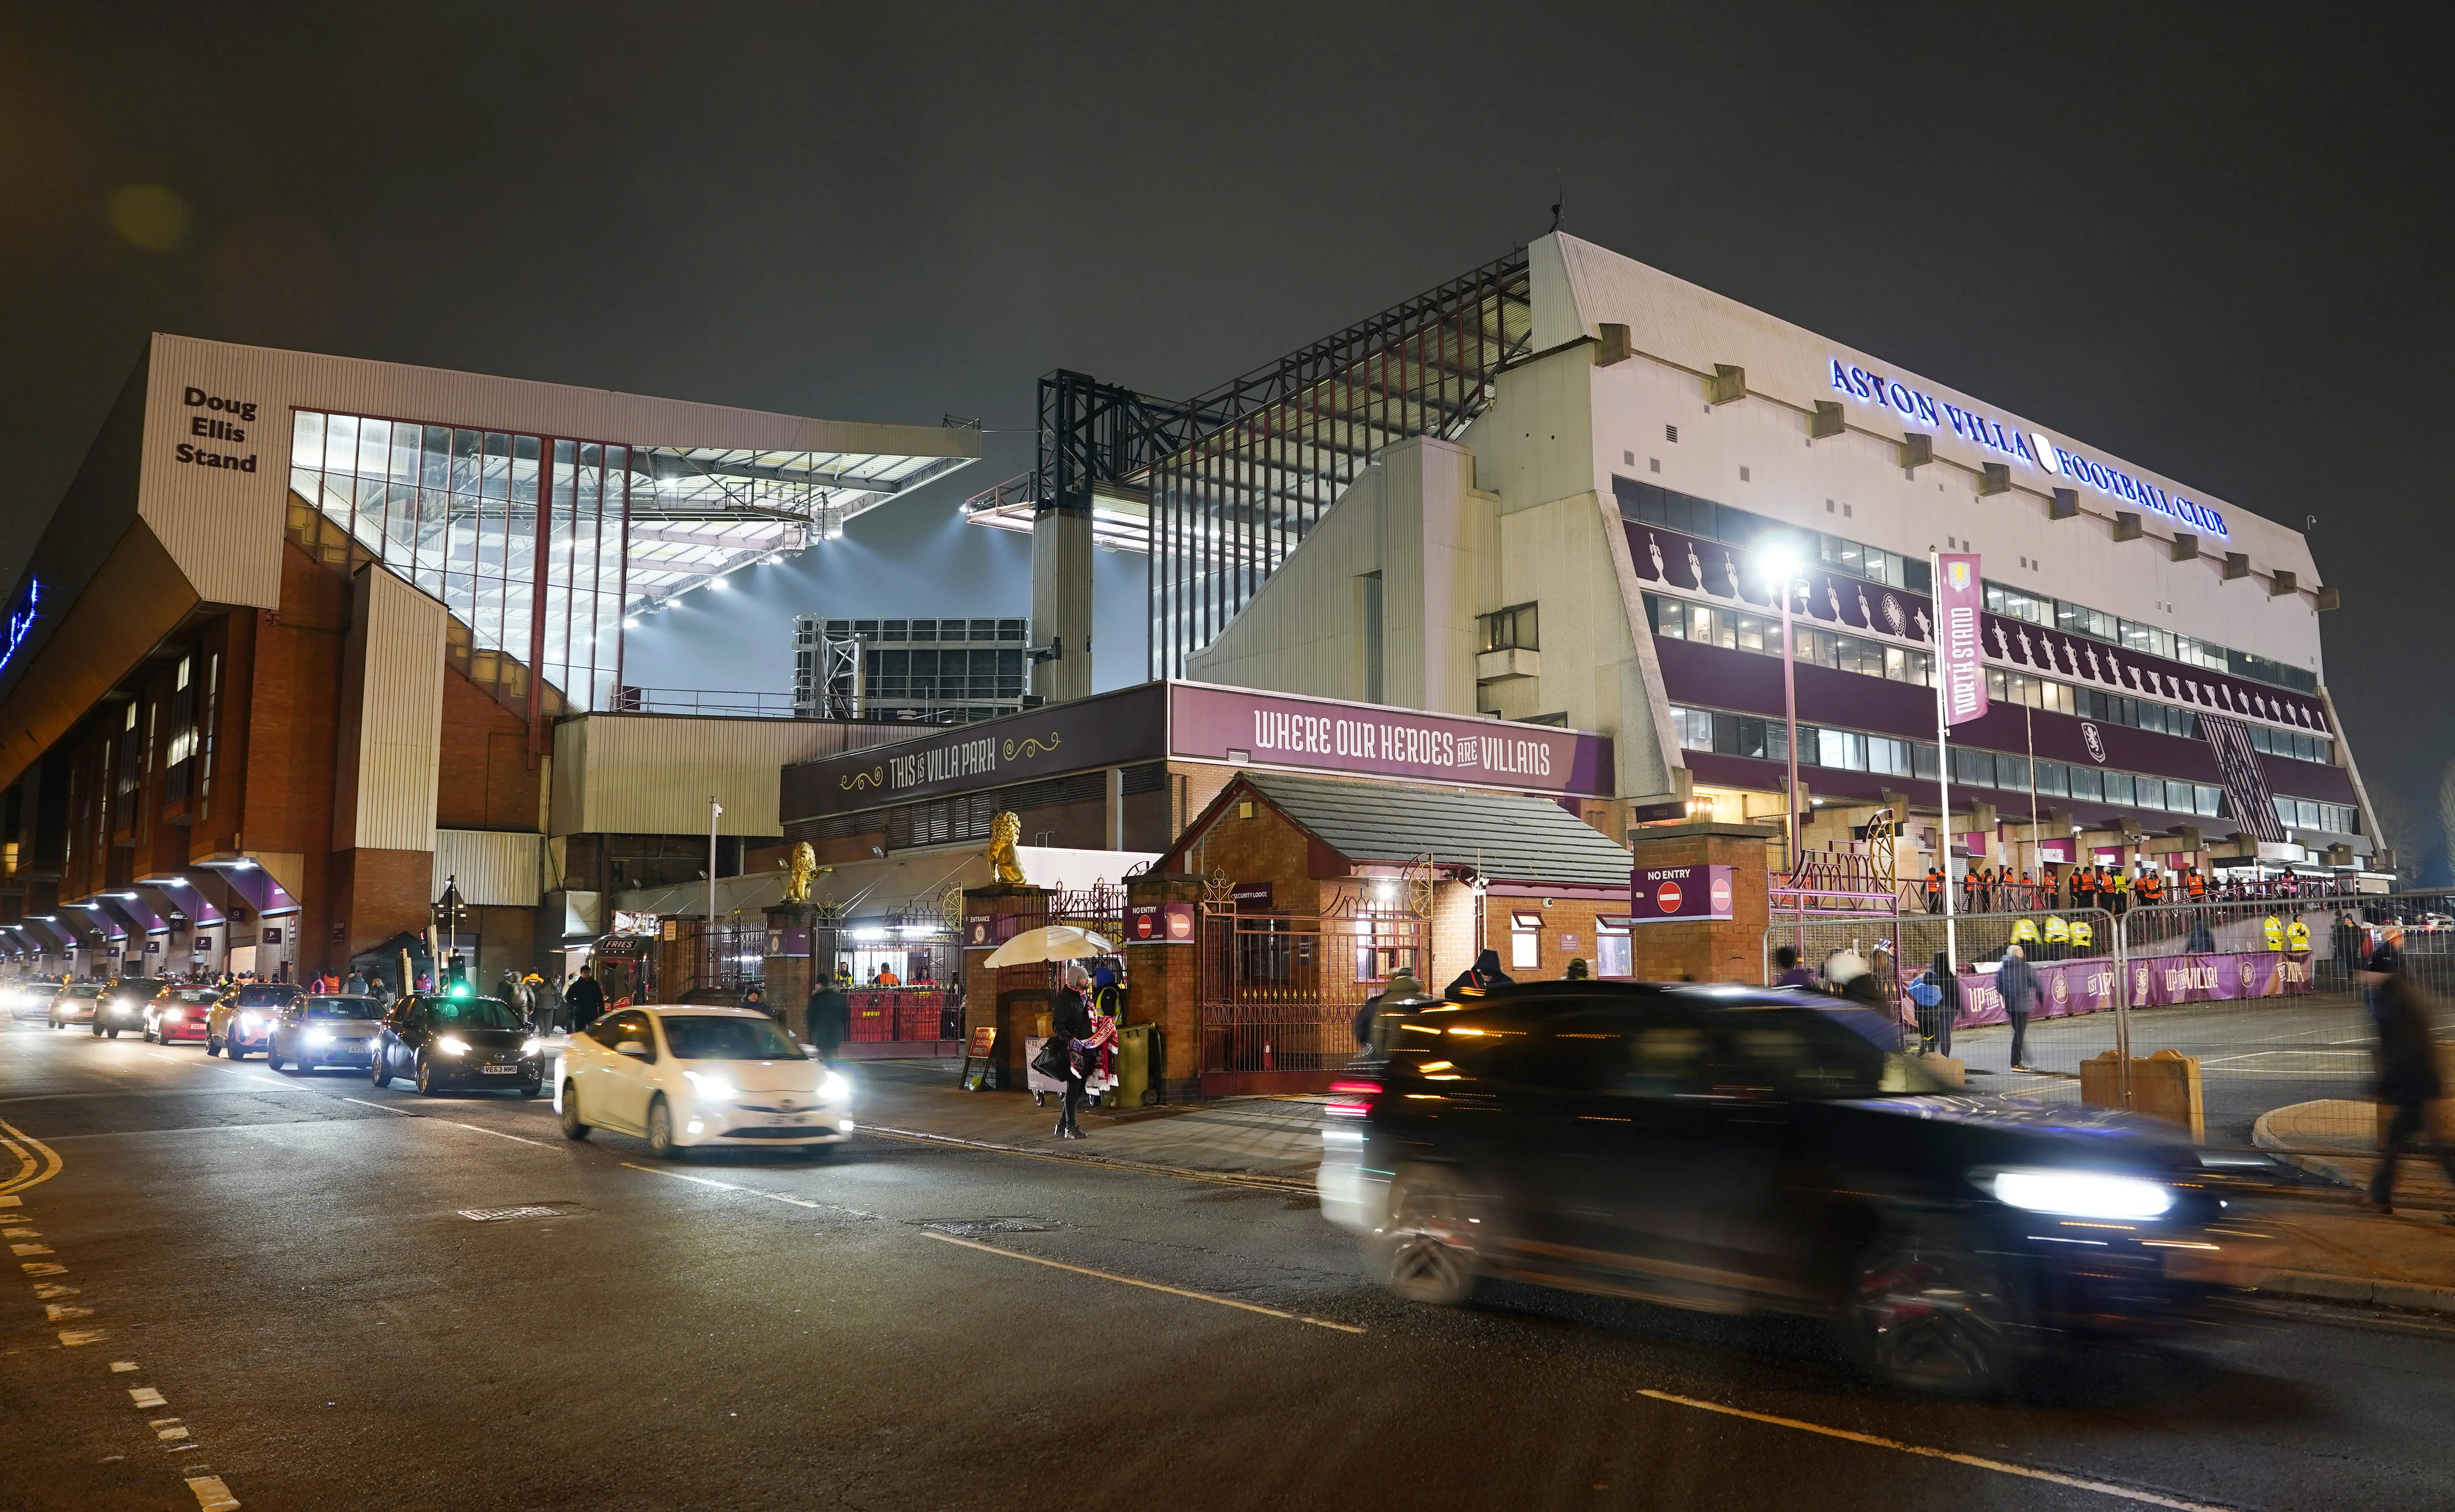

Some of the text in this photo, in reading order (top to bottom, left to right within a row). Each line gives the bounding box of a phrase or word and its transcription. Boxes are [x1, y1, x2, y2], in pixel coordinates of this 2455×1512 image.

[184, 387, 257, 422] Doug
[191, 416, 245, 443] Ellis
[176, 444, 257, 474] Stand
[1831, 359, 2228, 537] ASTON VILLA FOOTBALL CLUB
[1950, 607, 1978, 716] NORTH STAND
[1254, 709, 1551, 777] WHERE OUR HEROES ARE VILLANS
[889, 736, 996, 790] THIS IS VILLA PARK
[1647, 869, 1691, 881] NO ENTRY
[2088, 978, 2097, 993] EST
[2165, 966, 2219, 991] UP TH VILLA!
[1968, 987, 1985, 1013] UP
[1985, 989, 1999, 1007] THE
